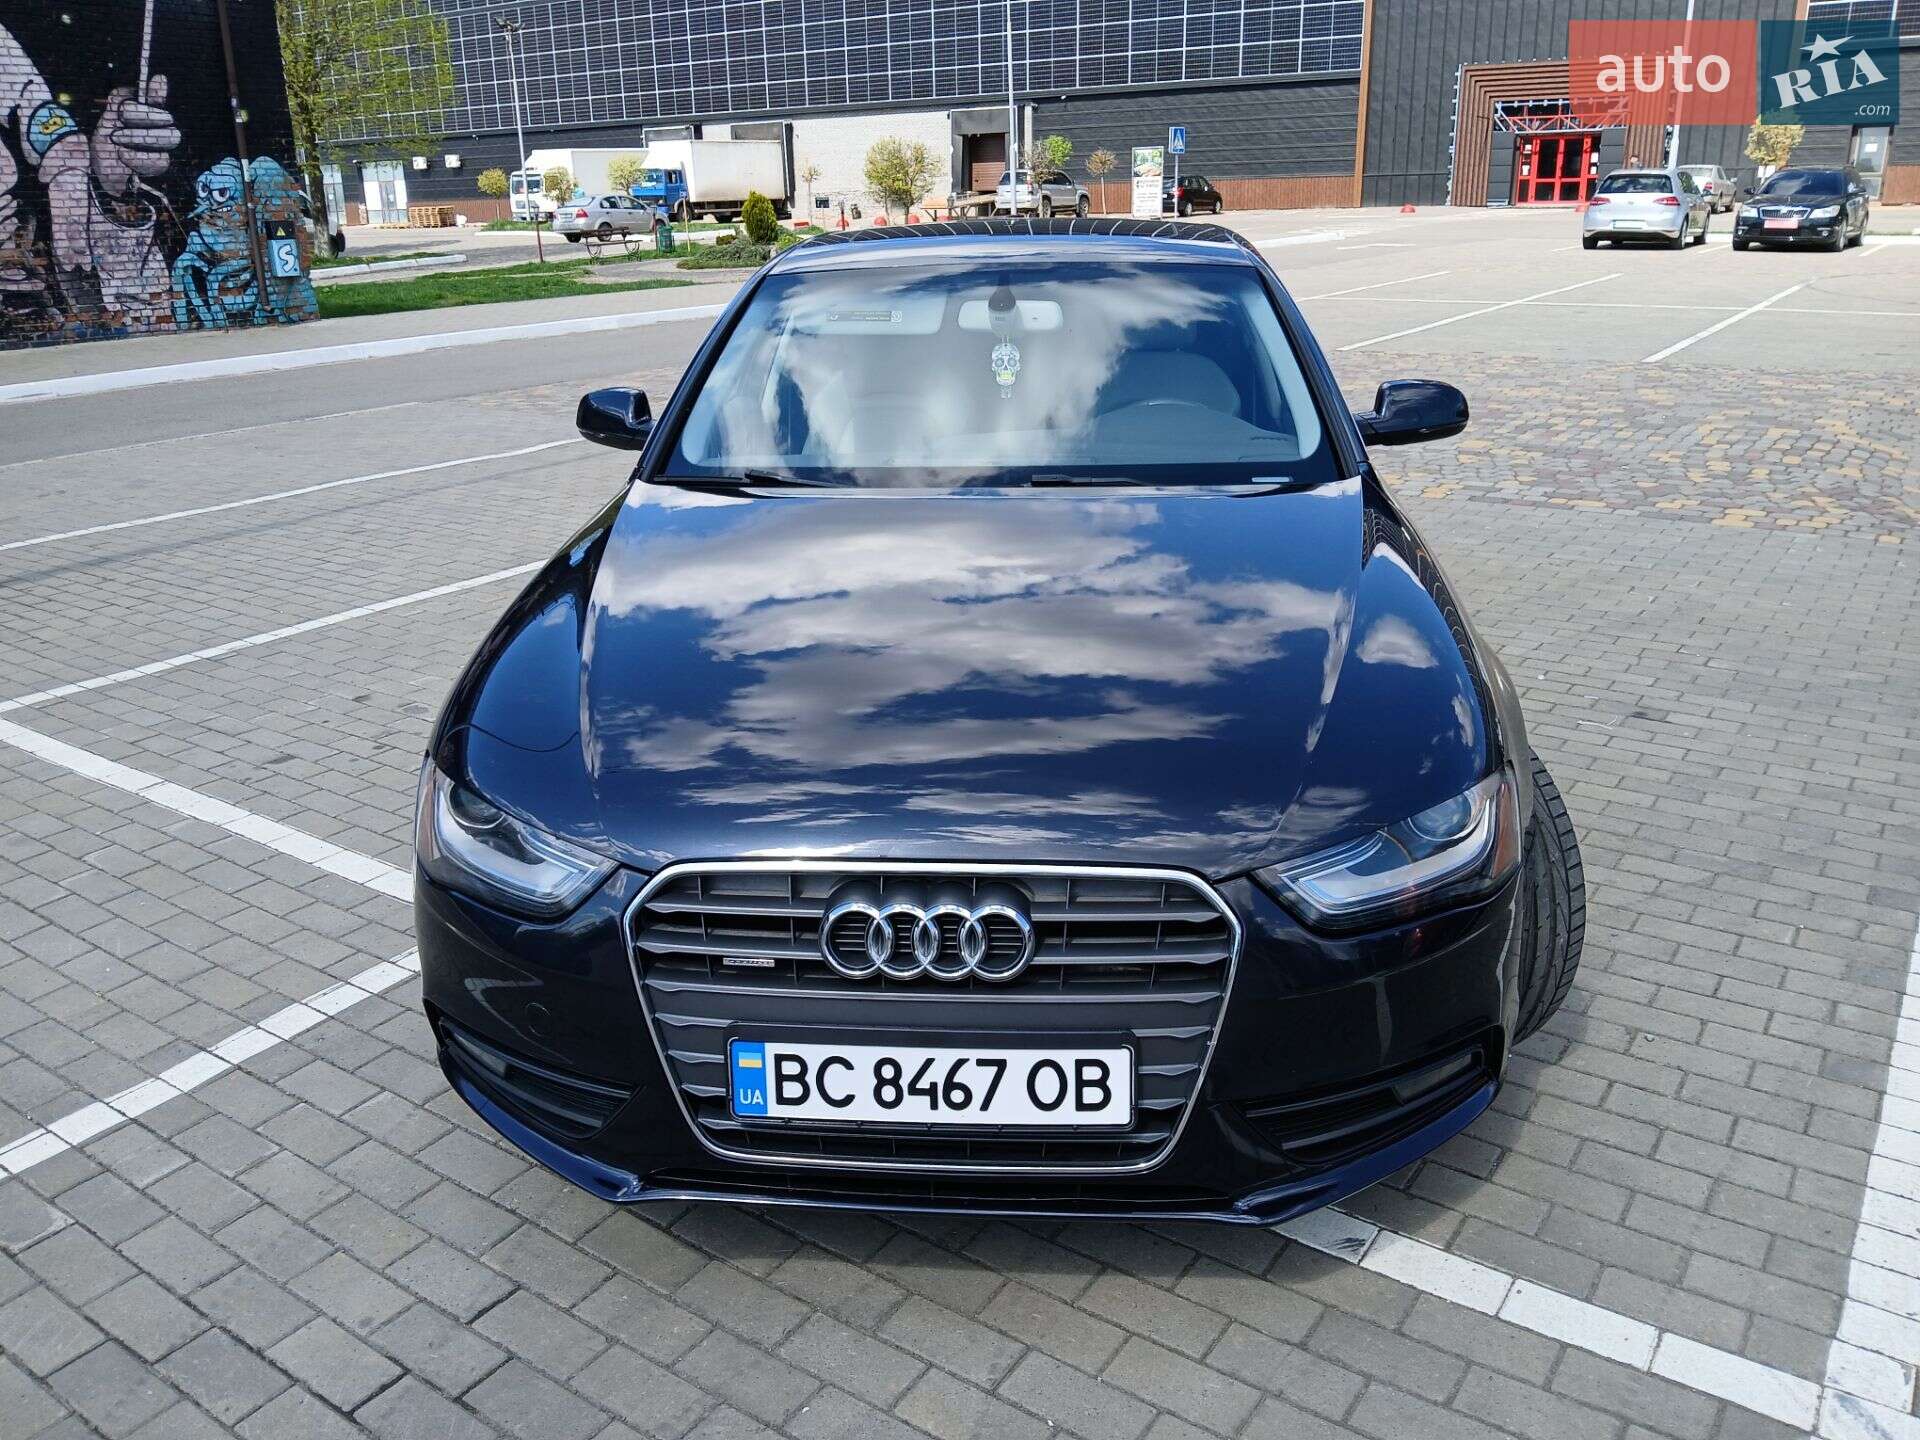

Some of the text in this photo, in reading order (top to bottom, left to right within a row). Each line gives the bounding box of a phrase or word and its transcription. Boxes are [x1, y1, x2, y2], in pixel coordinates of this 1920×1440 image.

[740, 1088, 764, 1105] UA
[773, 1053, 1112, 1112] BC 8467 OB
